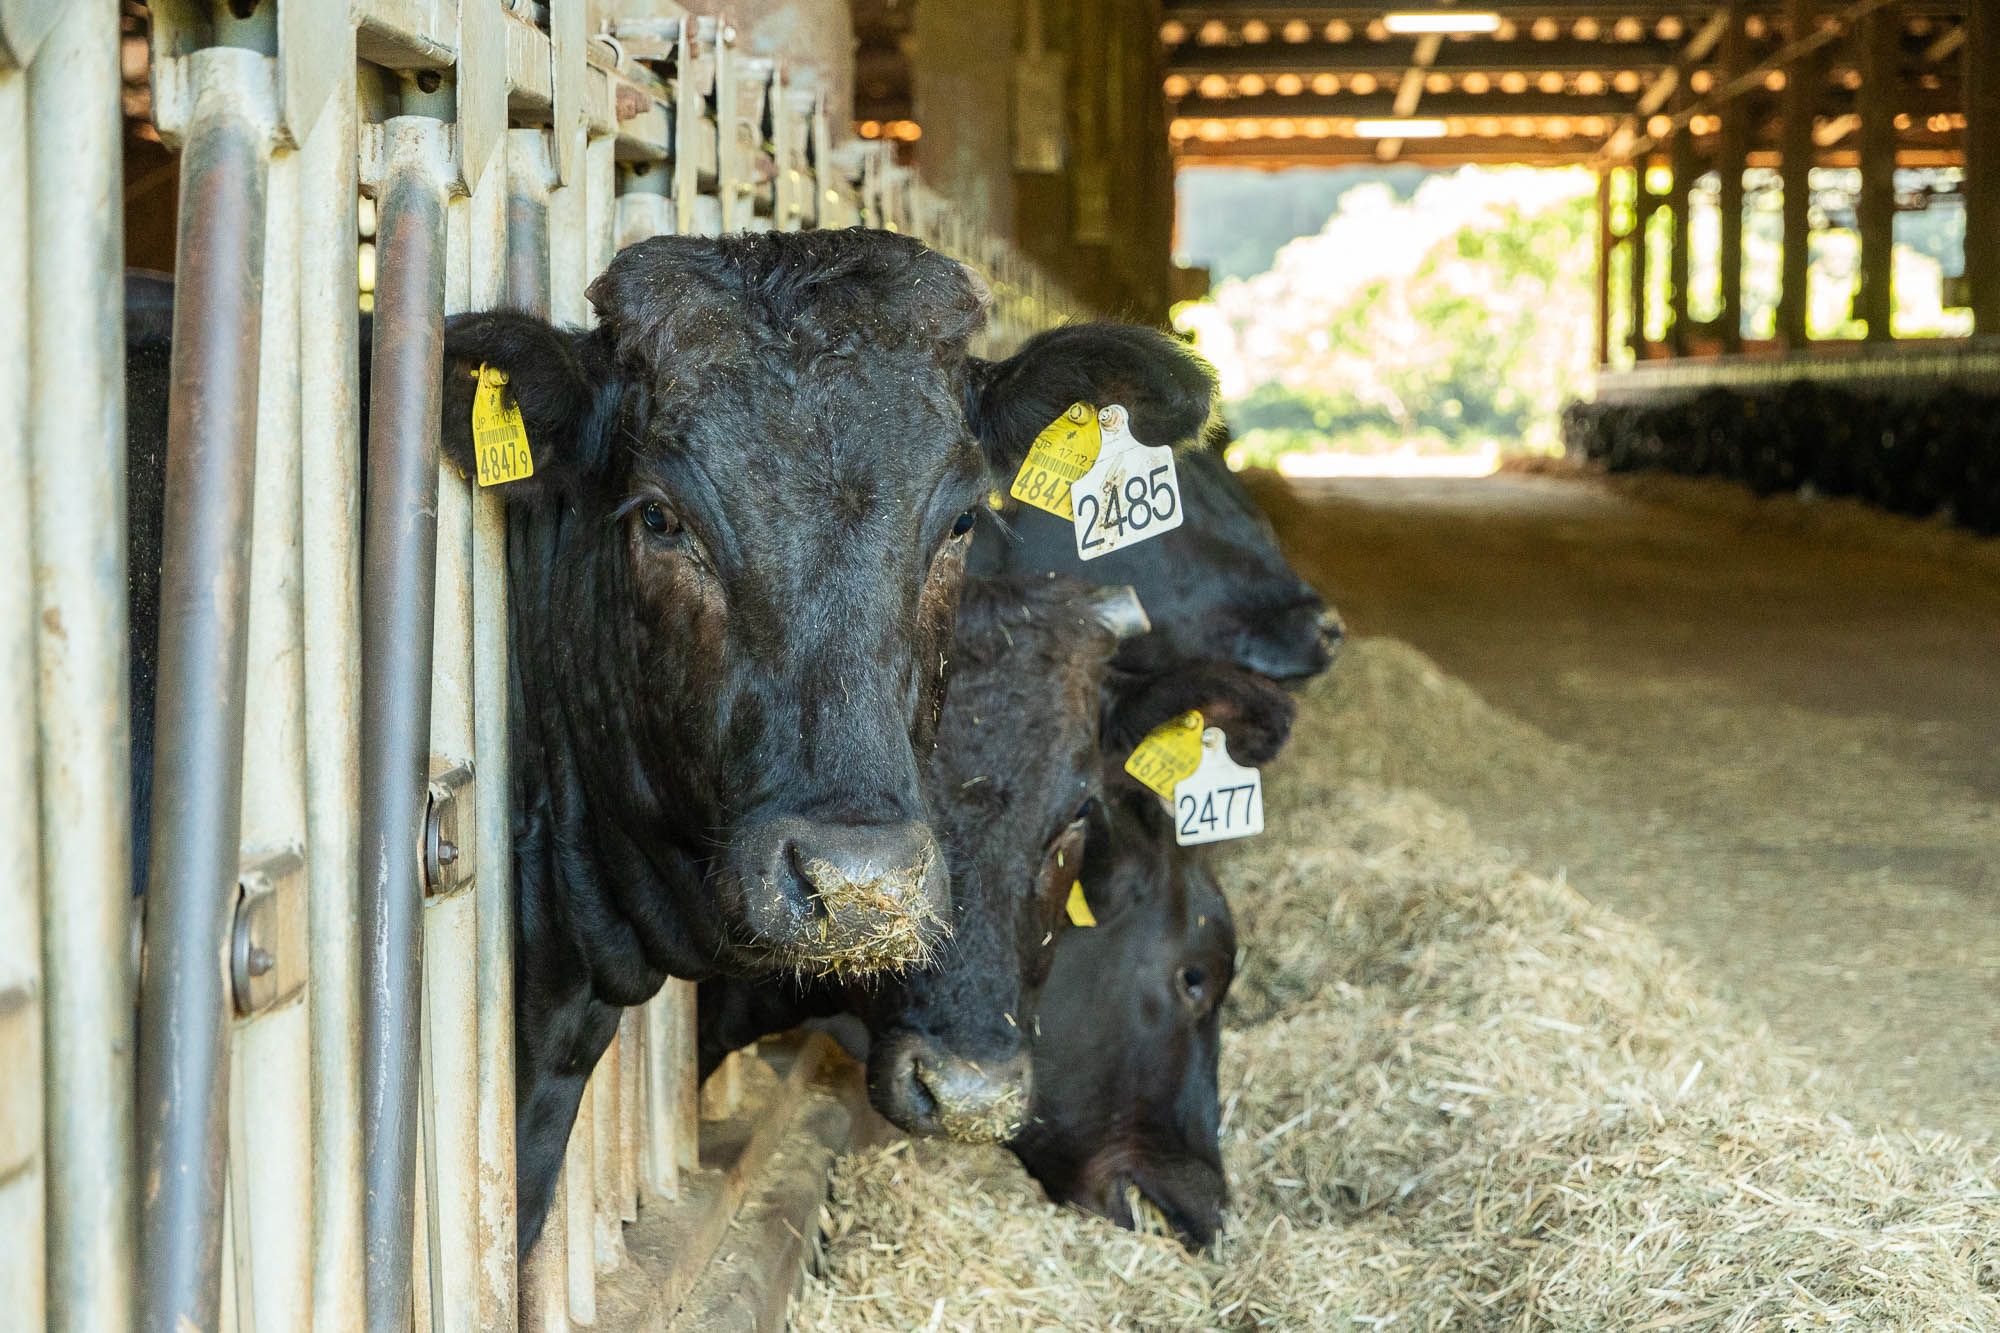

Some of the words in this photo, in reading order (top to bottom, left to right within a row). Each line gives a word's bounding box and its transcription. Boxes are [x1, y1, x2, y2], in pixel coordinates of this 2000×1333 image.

[1016, 466, 1073, 513] 4847
[1077, 464, 1176, 551] 2485
[1179, 783, 1256, 836] 2477
